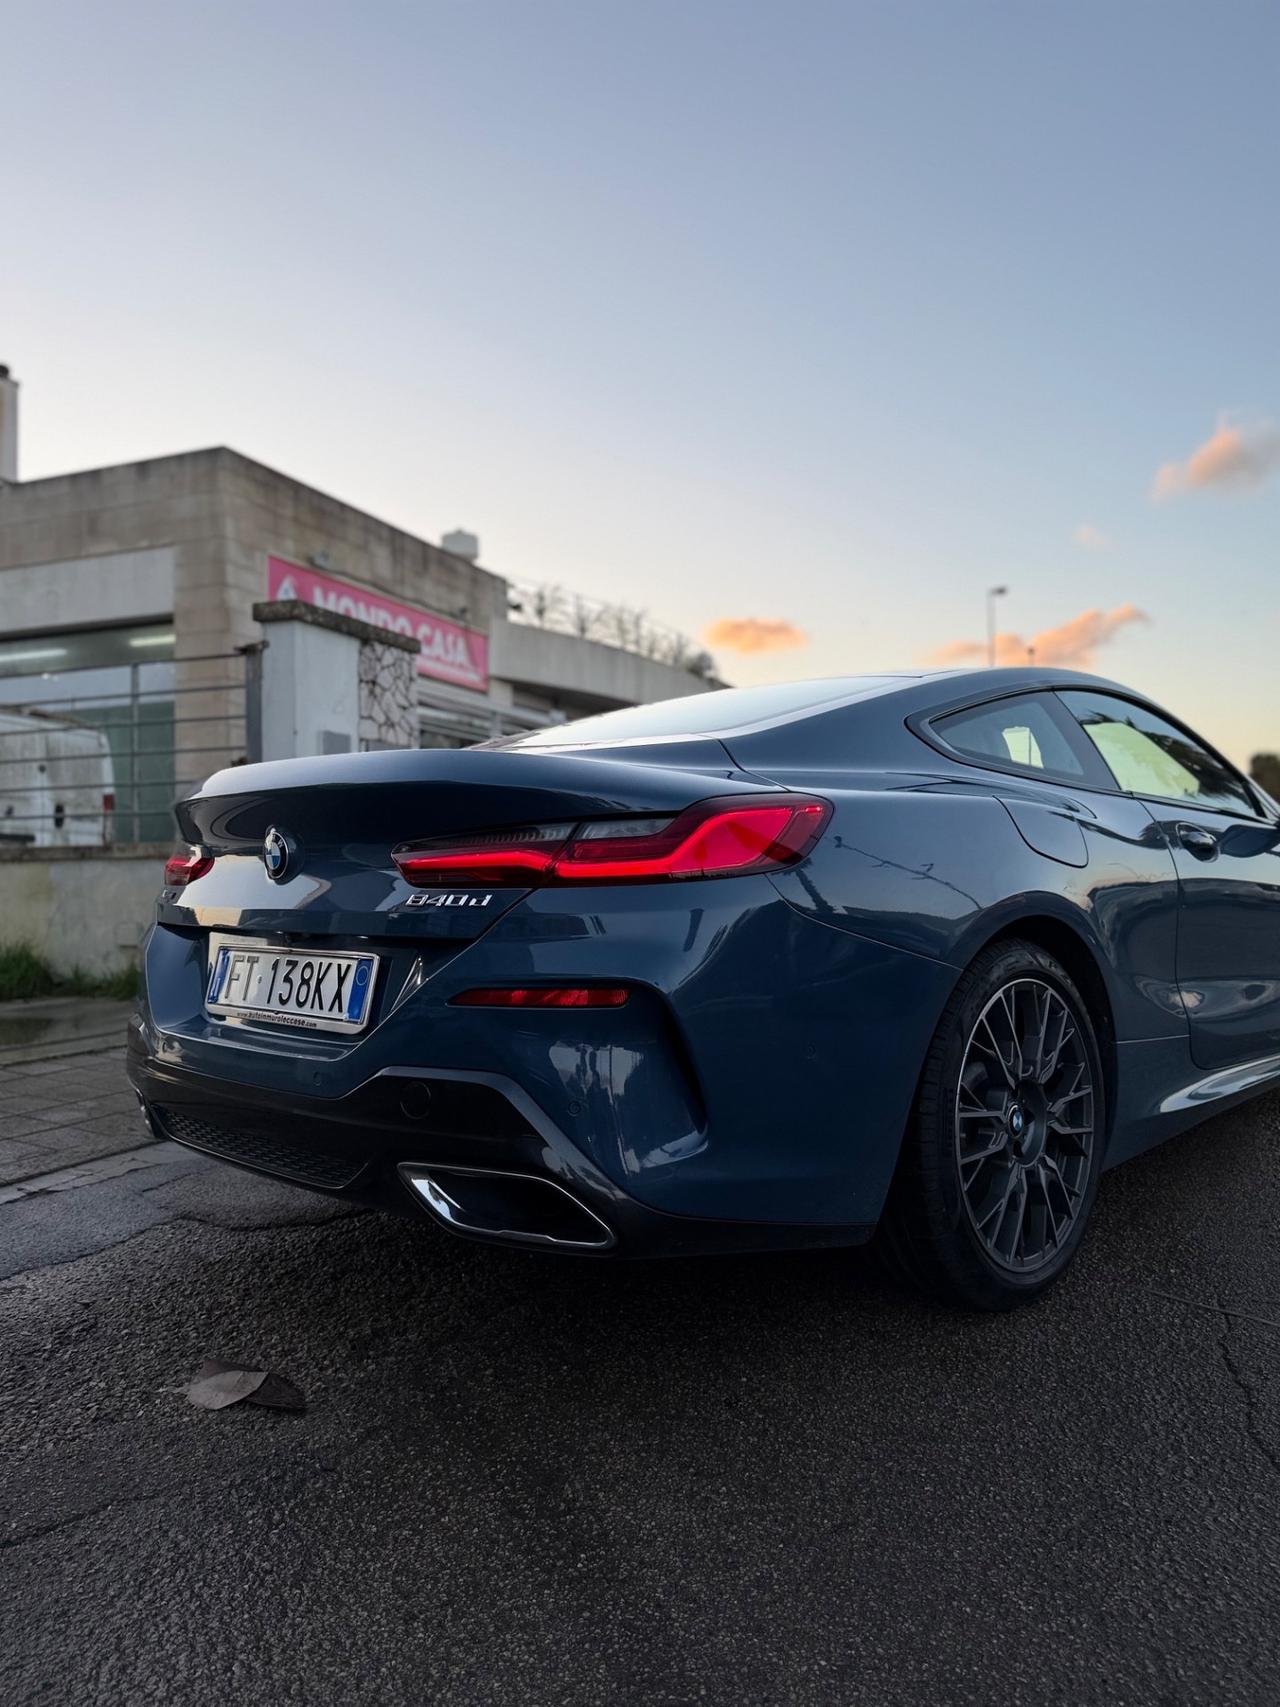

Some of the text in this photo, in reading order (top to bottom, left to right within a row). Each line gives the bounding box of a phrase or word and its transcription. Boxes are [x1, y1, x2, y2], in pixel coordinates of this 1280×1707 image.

[405, 894, 493, 907] 840d
[225, 954, 352, 1013] FT 138KX
